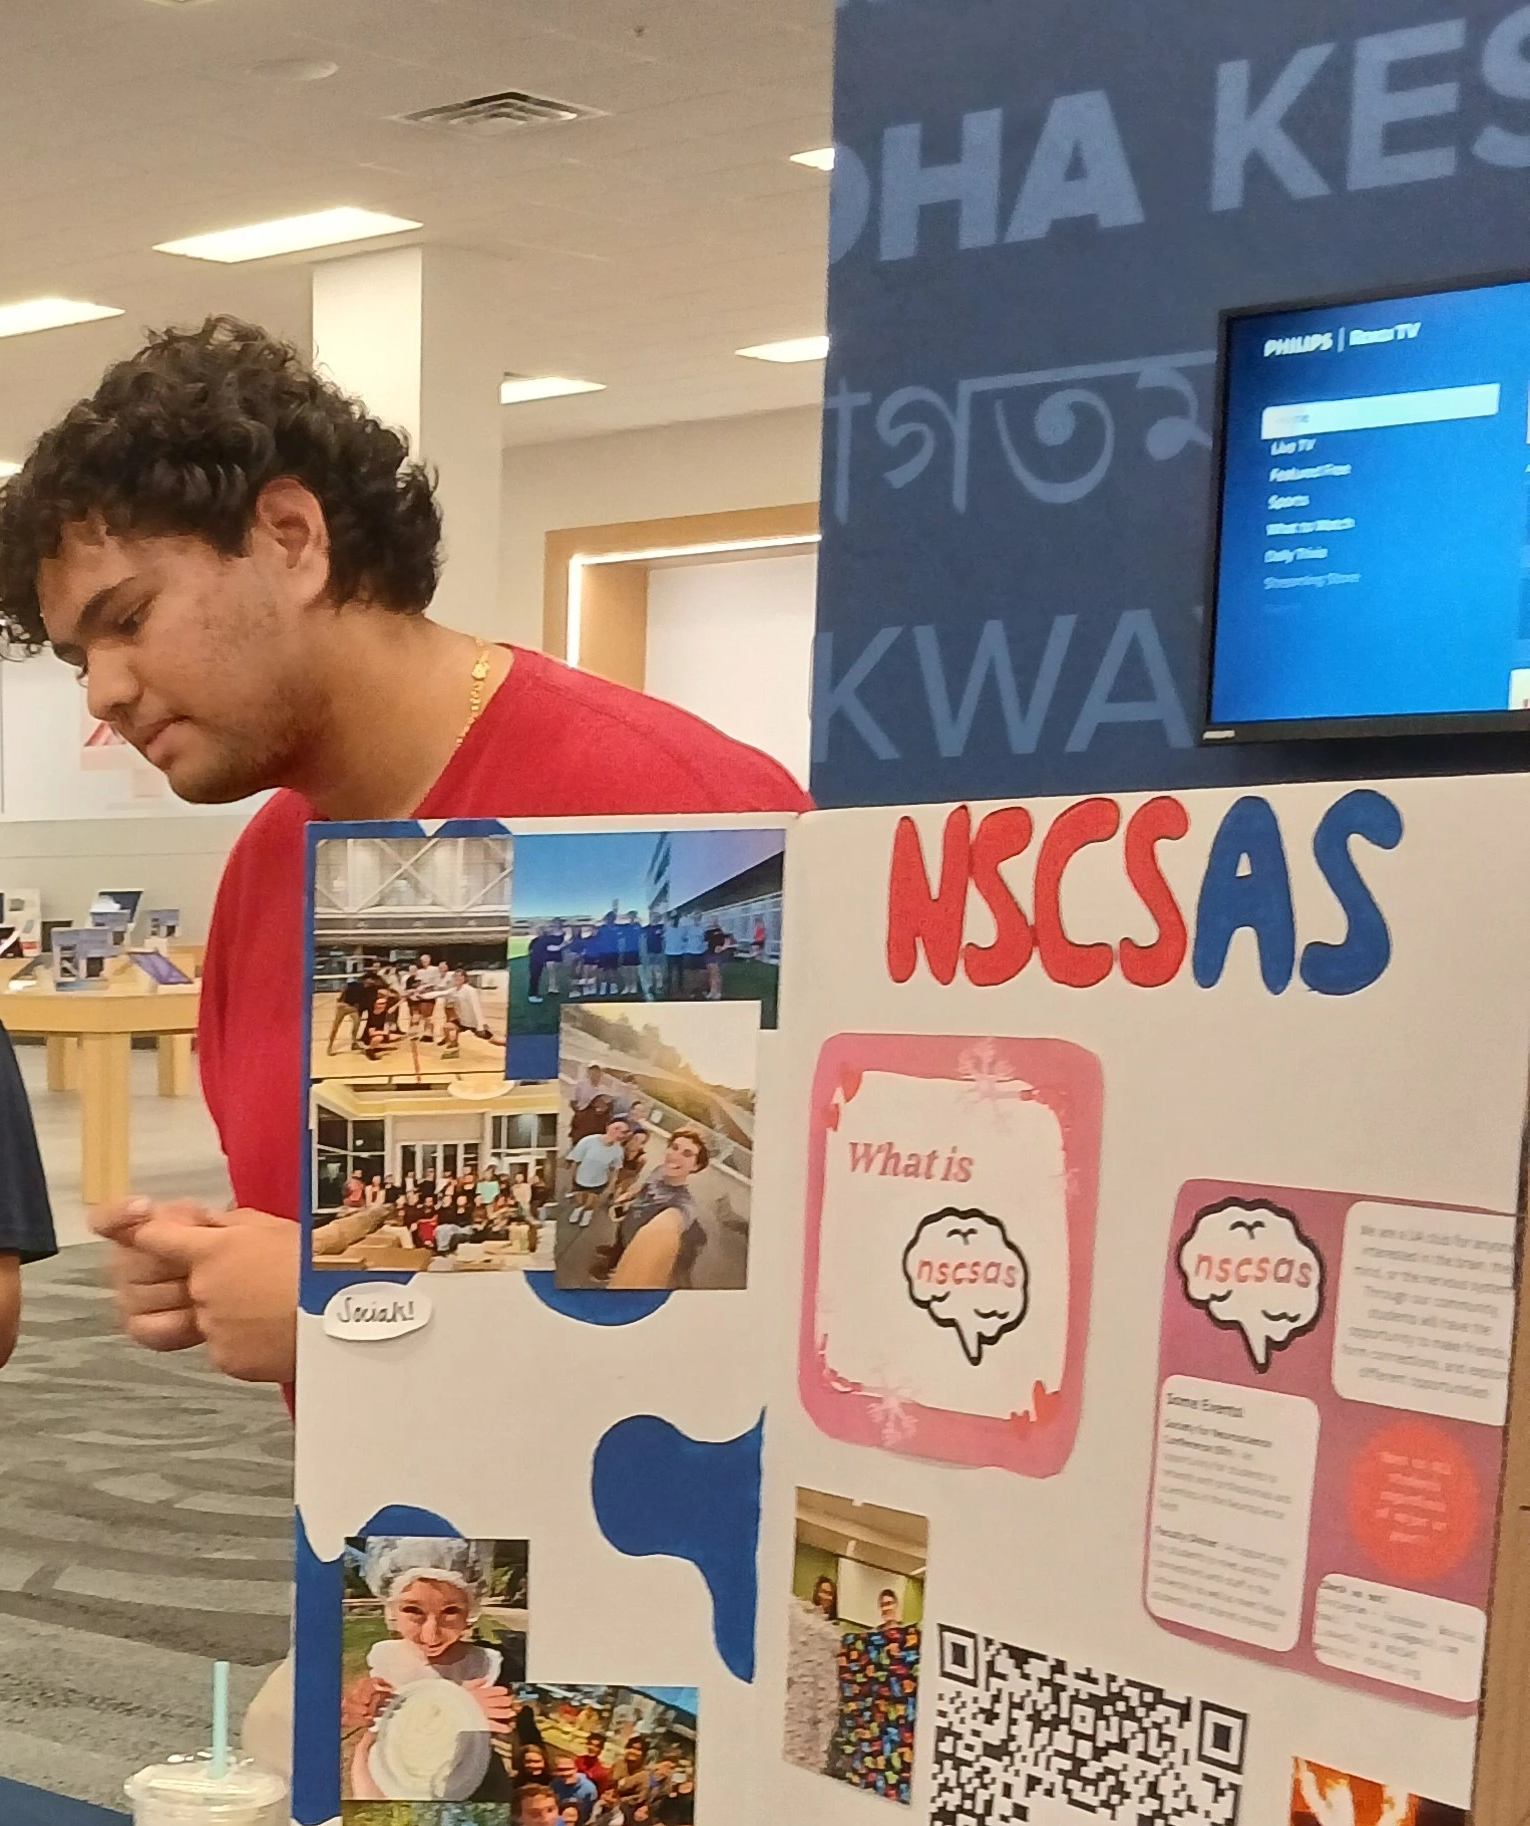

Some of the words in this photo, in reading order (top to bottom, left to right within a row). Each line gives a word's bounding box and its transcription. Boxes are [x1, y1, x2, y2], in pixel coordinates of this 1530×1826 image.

[1264, 332, 1334, 357] PHILIPS
[1394, 322, 1421, 340] TV
[811, 605, 1204, 760] KWA
[886, 788, 1404, 996] NSCSAS
[849, 1141, 935, 1181] What
[943, 1146, 974, 1184] is
[916, 1255, 1017, 1290] nscsas
[1194, 1252, 1313, 1289] nscsas
